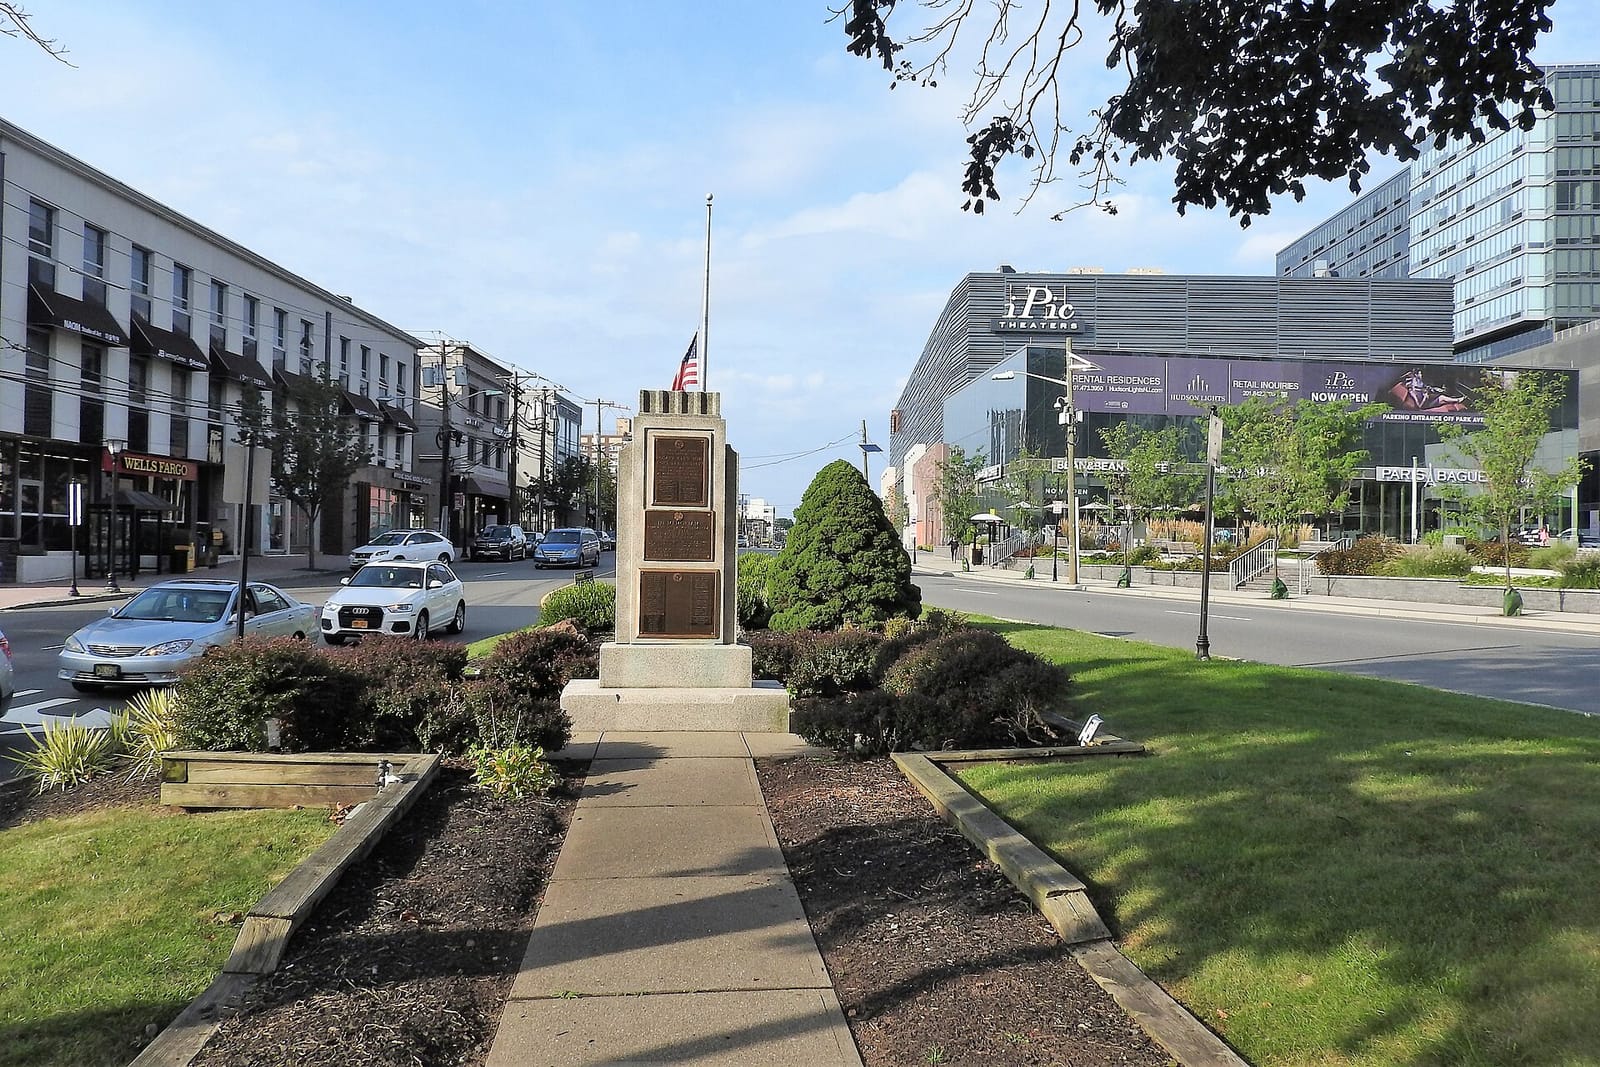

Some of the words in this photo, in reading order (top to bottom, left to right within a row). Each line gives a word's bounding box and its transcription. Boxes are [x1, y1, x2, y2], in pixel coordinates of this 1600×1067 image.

[1001, 286, 1075, 319] iPic
[999, 321, 1078, 330] THEATERS
[1072, 374, 1105, 384] RENTAL
[1106, 375, 1161, 386] RESIDENCES
[1232, 379, 1259, 389] RETAIL
[1260, 380, 1299, 391] INQUIRIES
[1325, 371, 1355, 387] iPic
[1170, 393, 1199, 402] HUDSON
[1200, 394, 1226, 402] LIGHTS
[1311, 392, 1338, 402] NOW
[1340, 392, 1369, 403] OPEN
[1382, 413, 1410, 421] PARKING
[1411, 414, 1442, 422] ENTRANCE
[1443, 415, 1454, 423] OFF
[1472, 416, 1484, 424] AVE
[124, 456, 158, 472] WELLS
[159, 461, 188, 476] FARGO
